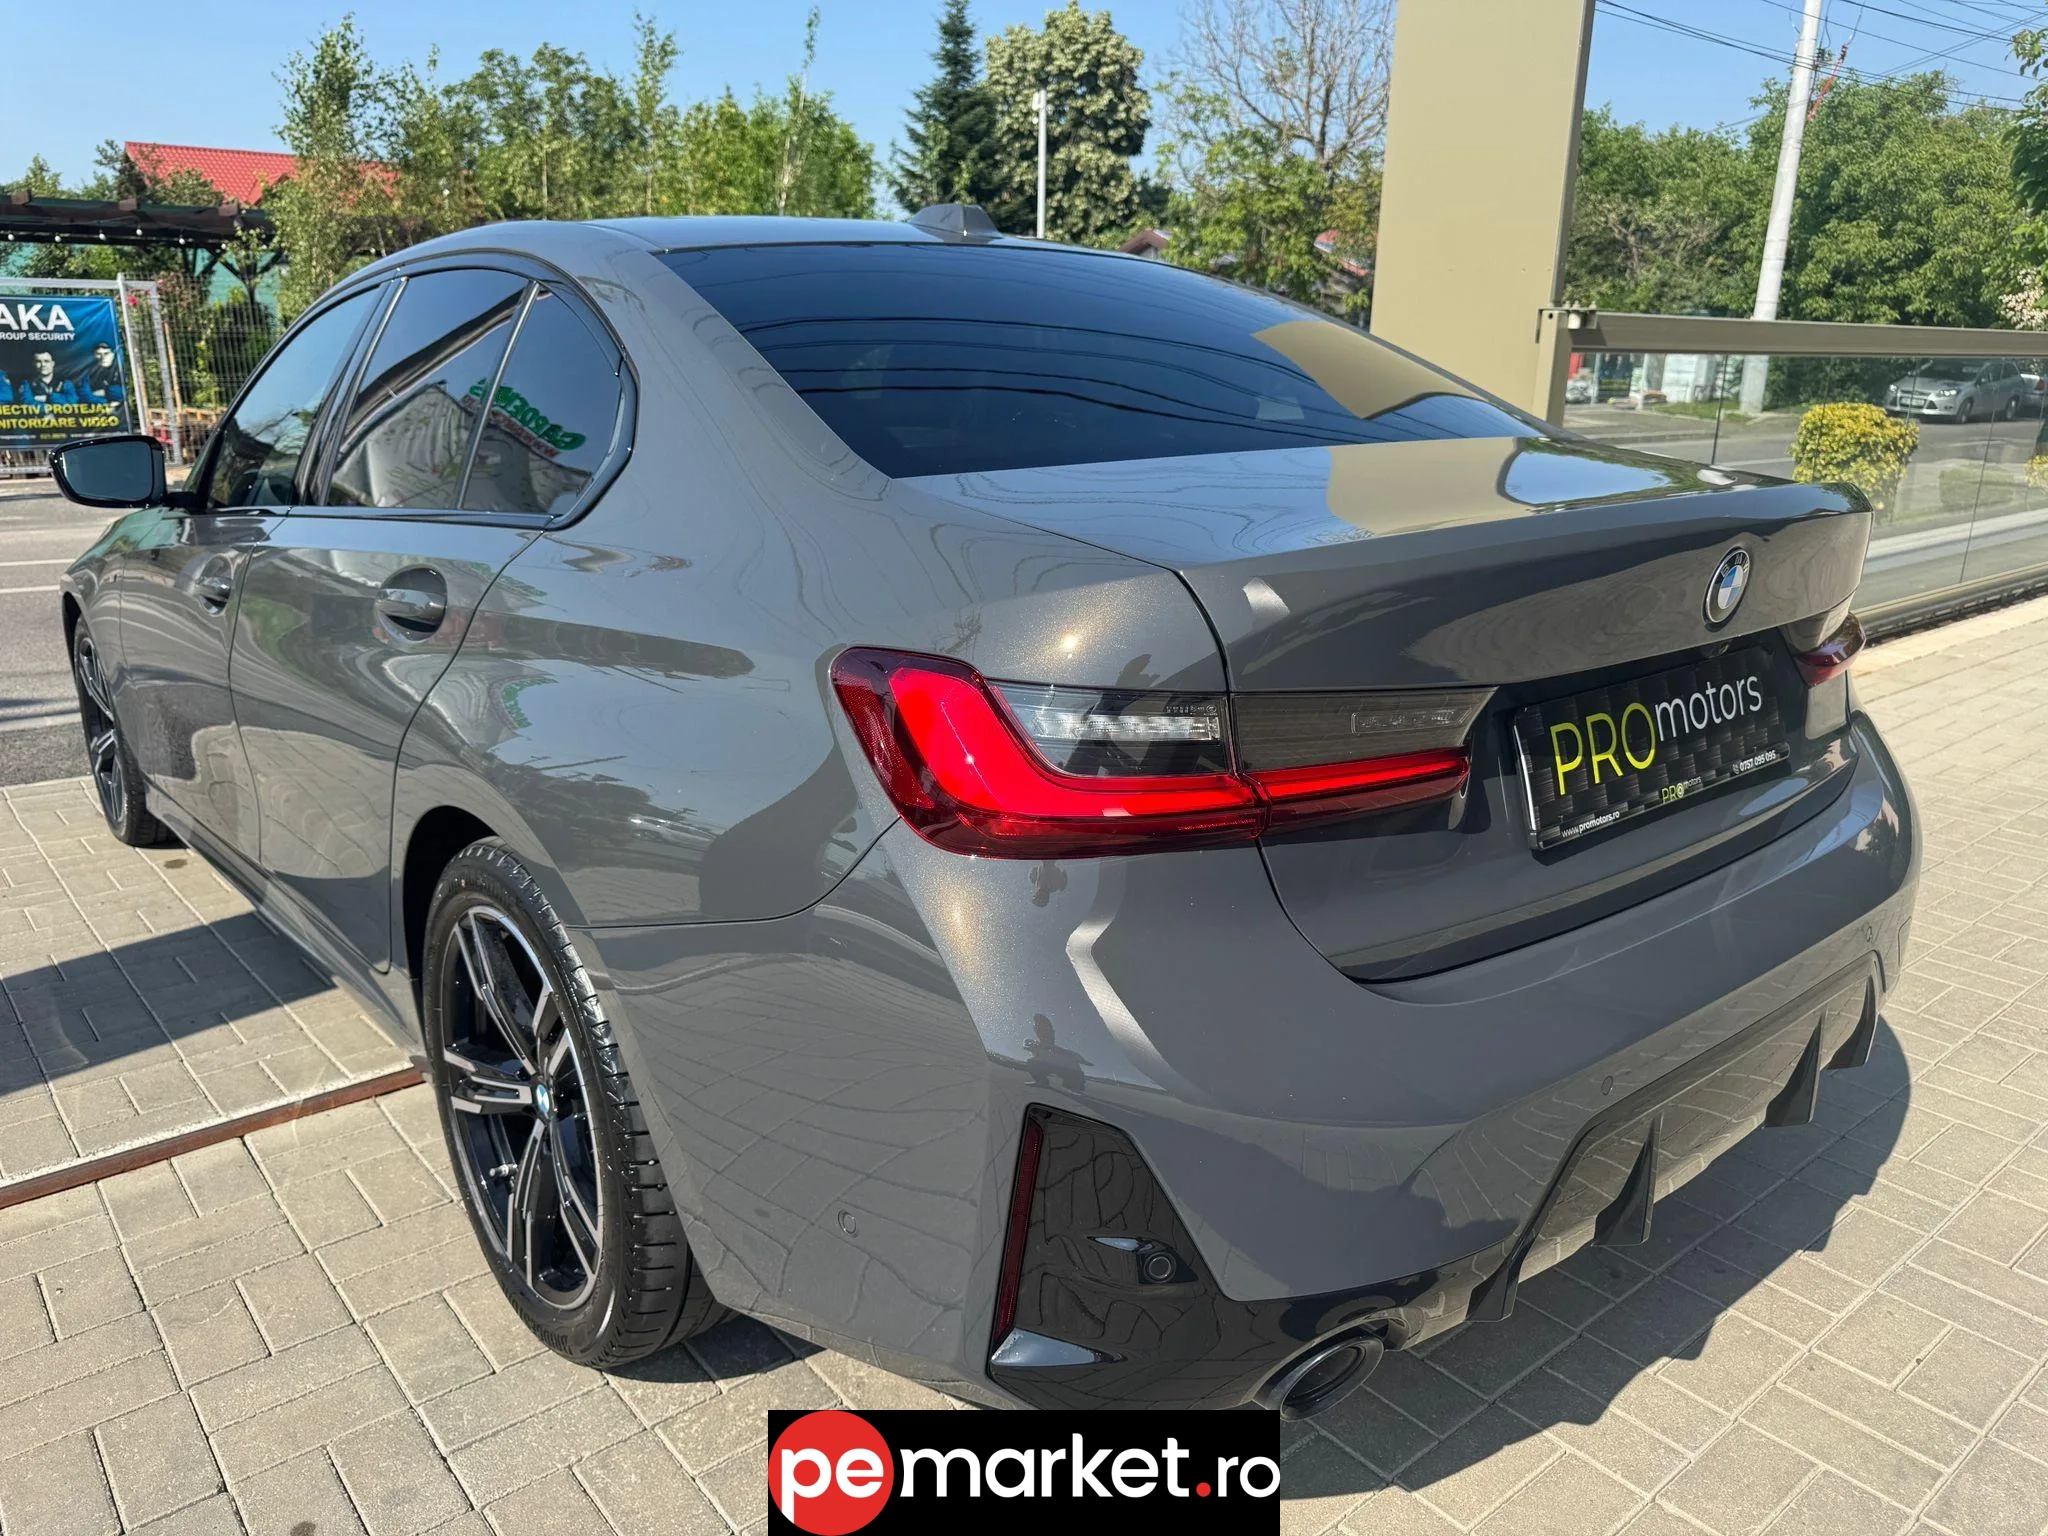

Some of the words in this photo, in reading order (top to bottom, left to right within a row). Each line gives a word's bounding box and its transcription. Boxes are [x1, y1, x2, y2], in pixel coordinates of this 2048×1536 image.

[0, 303, 75, 331] AKA
[28, 332, 75, 341] SECURITY
[79, 415, 119, 428] VIDEO
[1740, 759, 1753, 771] 0757
[1754, 754, 1765, 766] 095
[1765, 750, 1776, 762] 095
[1561, 810, 1620, 838] www.promotors.ro
